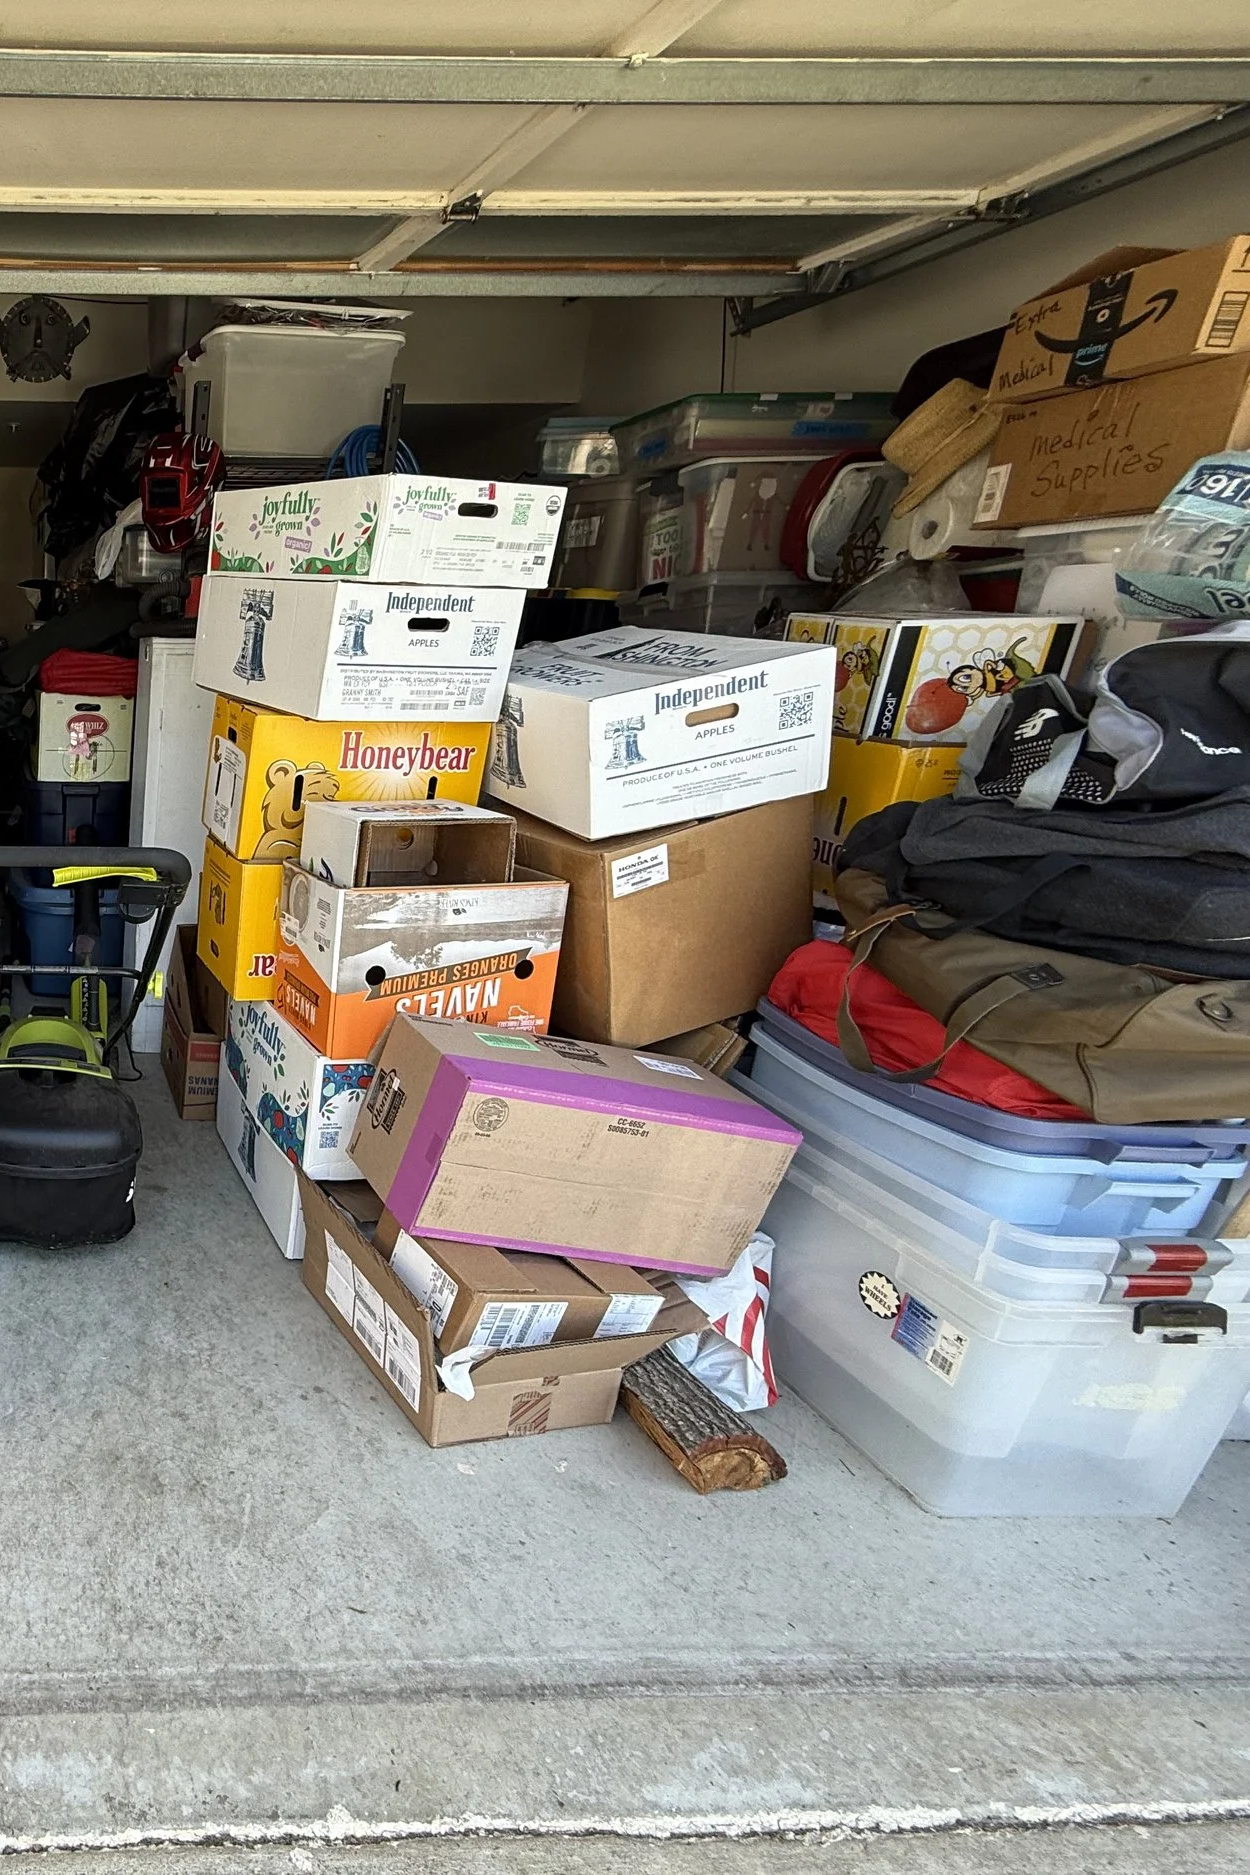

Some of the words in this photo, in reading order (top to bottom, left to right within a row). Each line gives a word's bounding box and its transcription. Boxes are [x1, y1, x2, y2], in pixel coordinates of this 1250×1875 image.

[1013, 300, 1063, 335] Extra
[1077, 343, 1108, 360] prime
[999, 354, 1054, 391] Medical
[1031, 443, 1170, 498] Supplies
[402, 485, 453, 506] joyfully
[259, 489, 316, 525] joyfully
[418, 502, 442, 513] grown
[276, 519, 303, 537] grown
[656, 529, 678, 546] TOO
[286, 538, 311, 552] organic!
[386, 592, 476, 614] Independent
[408, 639, 440, 648] APPLES
[645, 642, 717, 658] FROM
[510, 666, 591, 687] ROWERS
[540, 663, 604, 678] FRUIT
[654, 670, 769, 715] Independent
[85, 722, 104, 730] WHIZ
[832, 706, 848, 732] ple
[695, 724, 735, 740] APPLES
[340, 732, 476, 776] Honeybear
[622, 773, 663, 788] PRODUCE
[663, 770, 675, 780] OF
[676, 766, 702, 776] U.S.A.
[710, 760, 728, 770] ONE
[730, 752, 764, 766] VOLUME
[764, 745, 798, 758] BUSHEL
[619, 860, 649, 872] HONDA
[452, 953, 518, 980] ORANGES
[380, 968, 448, 996] PREMIUM
[286, 984, 316, 1026] NAVELS
[396, 978, 502, 1017] NAVELS
[467, 1011, 488, 1024] KIN
[244, 1004, 285, 1062] joyfully
[254, 1037, 272, 1067] grown
[188, 1086, 218, 1096] EMIUM
[374, 1074, 394, 1124] Hormel
[617, 1118, 646, 1129] CC-6652
[865, 1286, 892, 1312] WHEELS
[873, 1285, 888, 1299] HAVE
